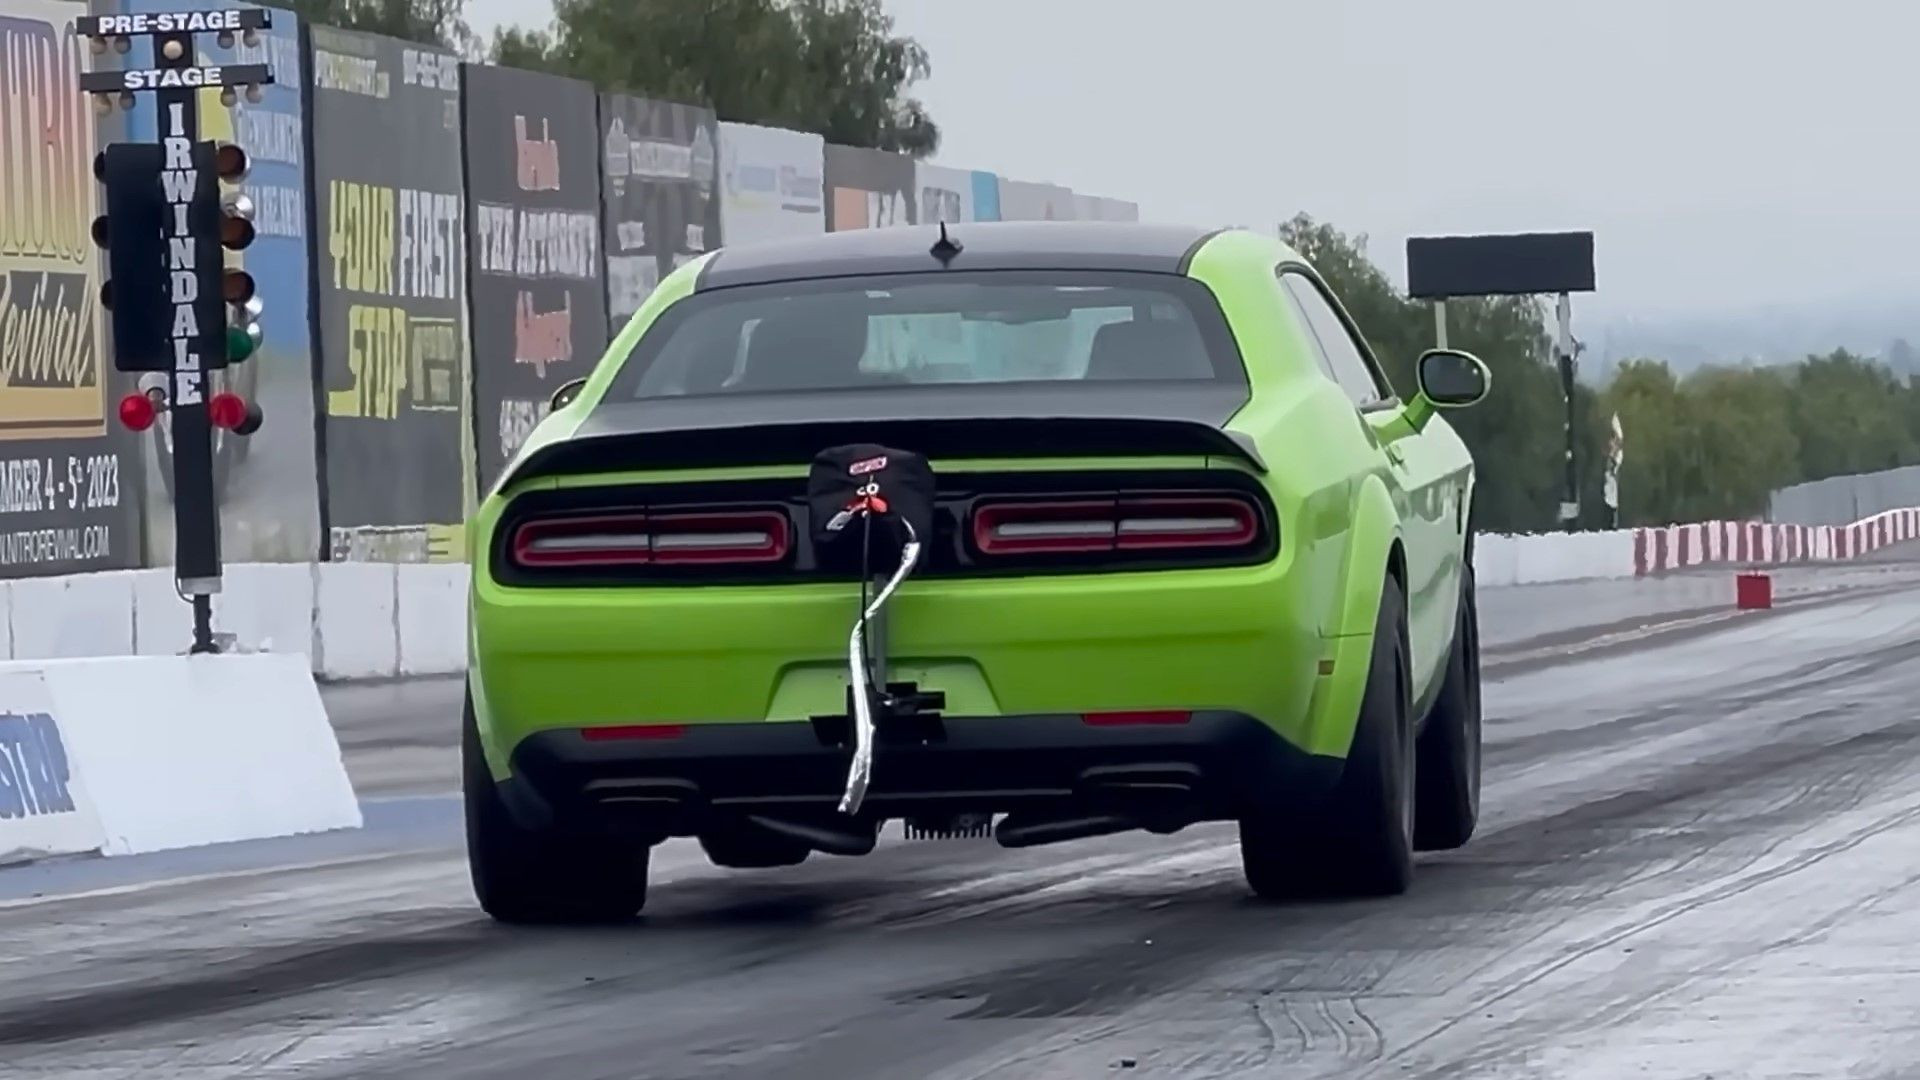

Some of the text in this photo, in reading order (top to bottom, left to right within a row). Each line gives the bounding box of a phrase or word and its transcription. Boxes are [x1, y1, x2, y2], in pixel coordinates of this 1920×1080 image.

[98, 10, 242, 35] PRE-STAGE
[124, 67, 223, 90] STAGE
[161, 102, 203, 406] IRWINDALE
[329, 179, 395, 296] YOUR
[399, 188, 458, 300] FIRST
[331, 304, 407, 420] STOP
[45, 457, 55, 510] 4
[58, 482, 65, 493] -
[87, 454, 119, 508] 2023
